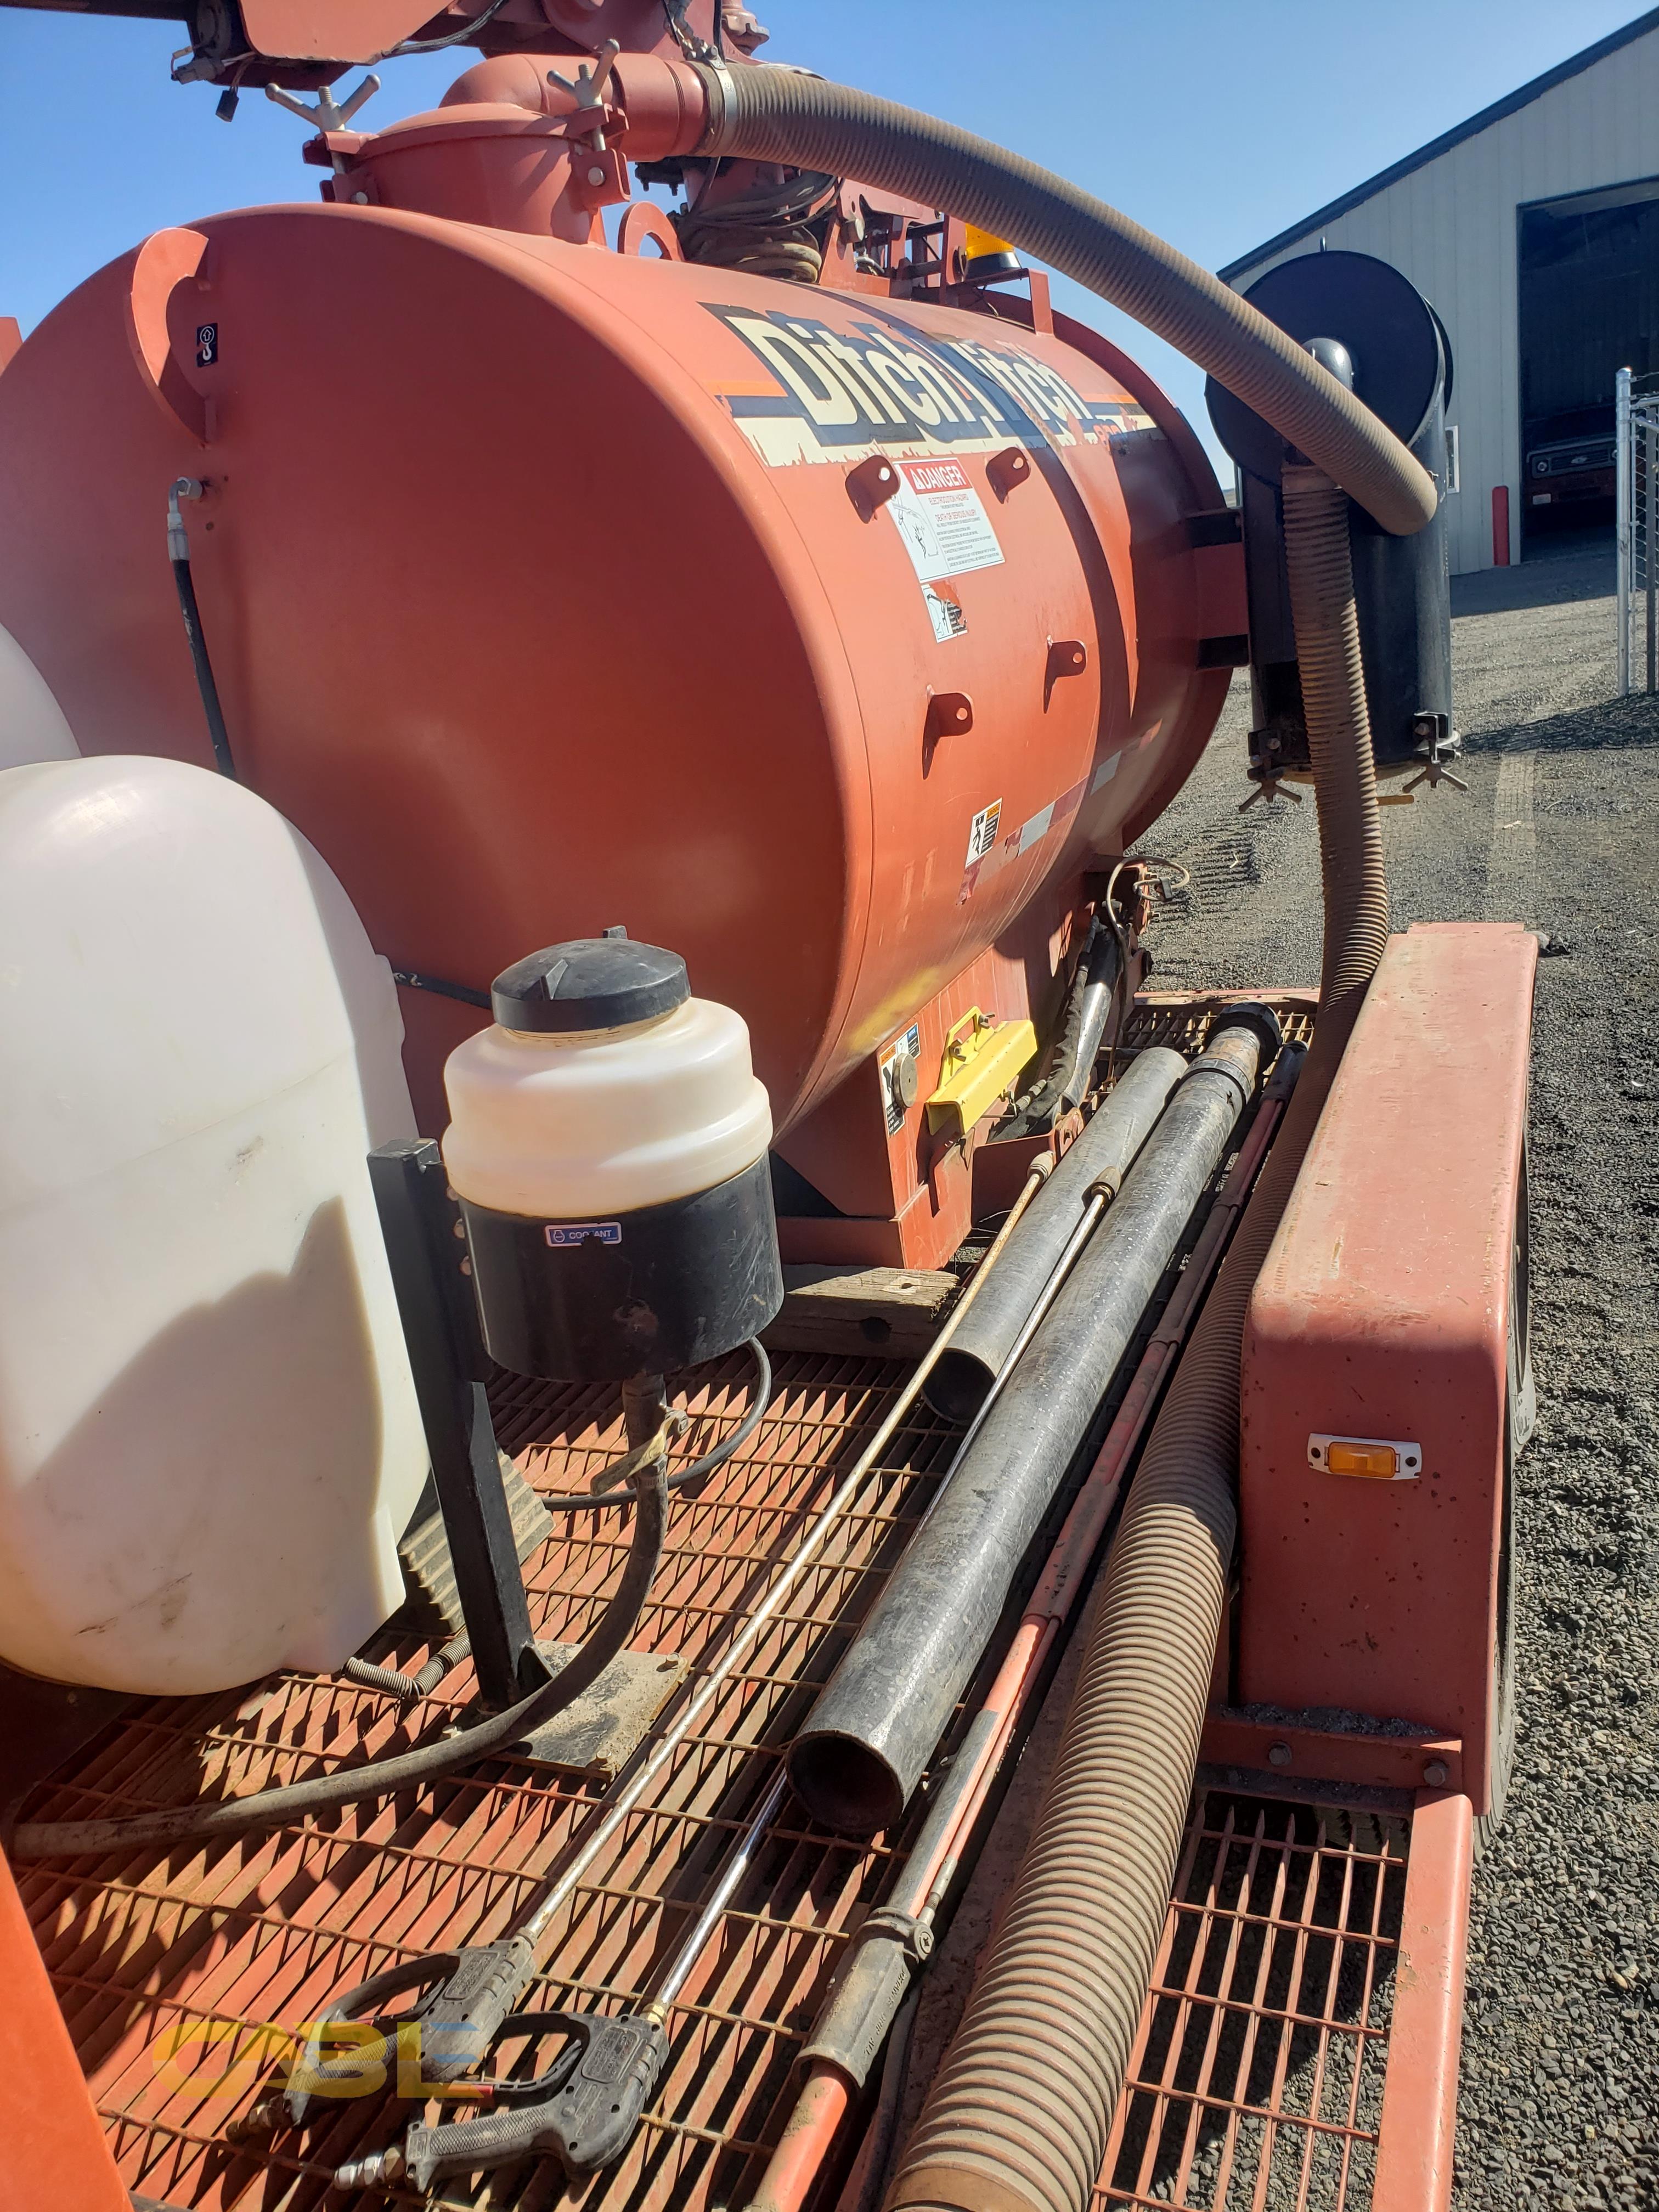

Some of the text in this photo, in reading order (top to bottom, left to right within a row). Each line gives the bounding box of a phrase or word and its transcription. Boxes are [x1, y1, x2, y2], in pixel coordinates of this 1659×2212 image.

[724, 317, 976, 426] Ditch
[916, 465, 967, 489] DANGER
[569, 1229, 612, 1239] COOANT
